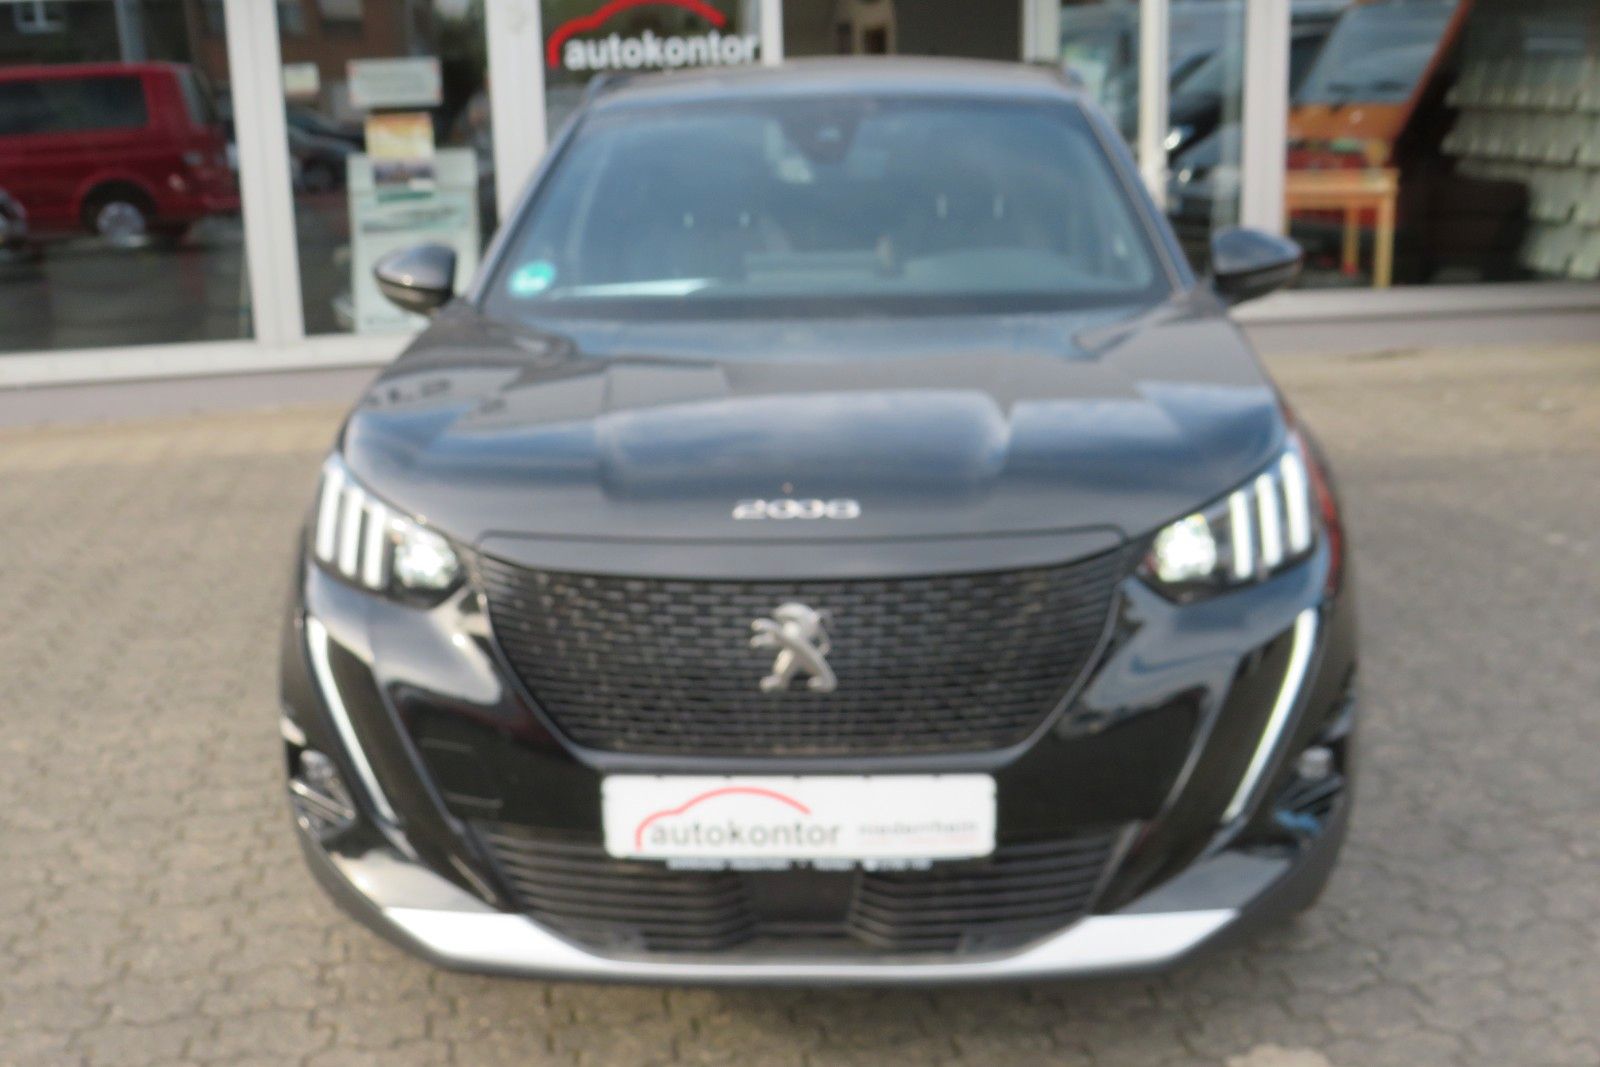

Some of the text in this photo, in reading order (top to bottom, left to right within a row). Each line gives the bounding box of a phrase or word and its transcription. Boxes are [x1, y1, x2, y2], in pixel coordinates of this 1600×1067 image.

[564, 29, 759, 71] autokontor
[732, 499, 860, 520] 2008
[651, 820, 840, 847] autokontor
